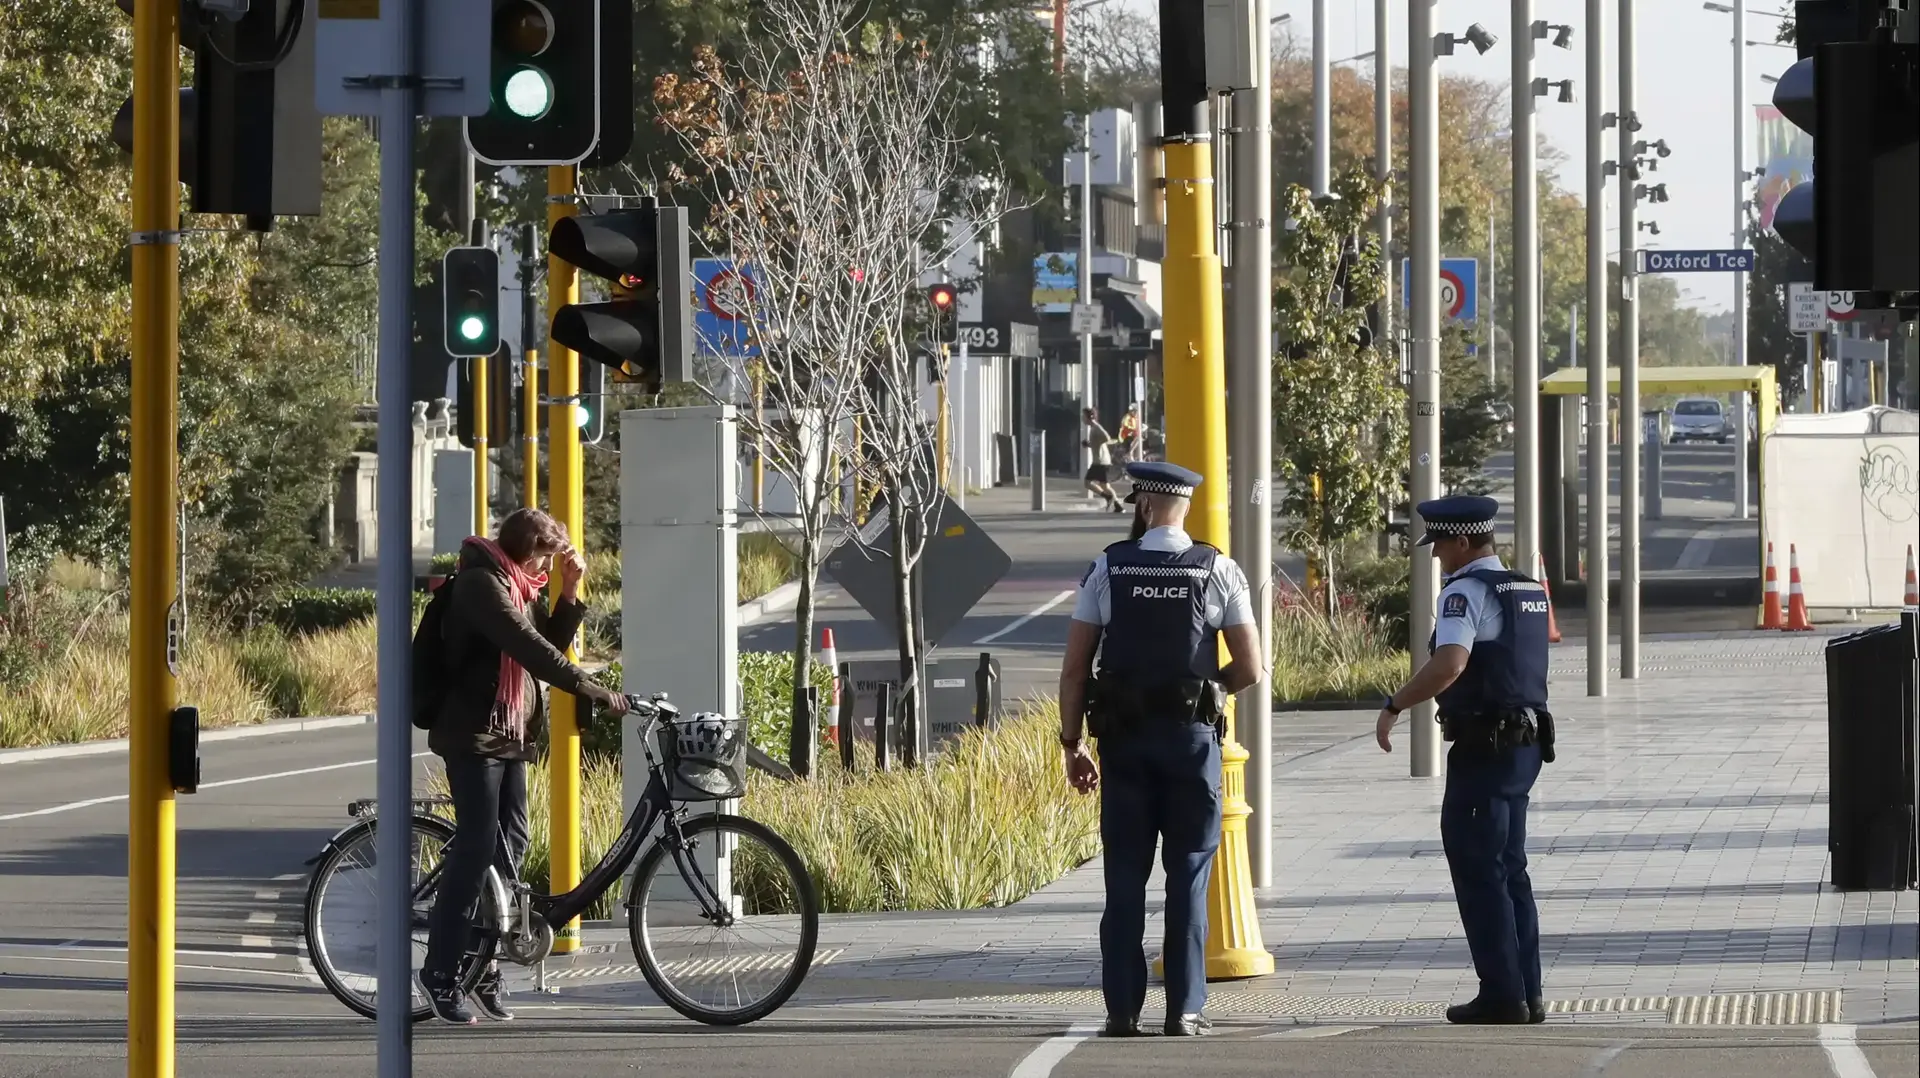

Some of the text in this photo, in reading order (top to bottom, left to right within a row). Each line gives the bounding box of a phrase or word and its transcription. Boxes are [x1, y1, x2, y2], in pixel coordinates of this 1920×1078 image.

[1650, 253, 1747, 269] Oxford Tce
[1441, 286, 1453, 303] 0
[1831, 290, 1856, 306] 50
[1132, 586, 1189, 598] POLICE
[1522, 601, 1547, 612] POLICE
